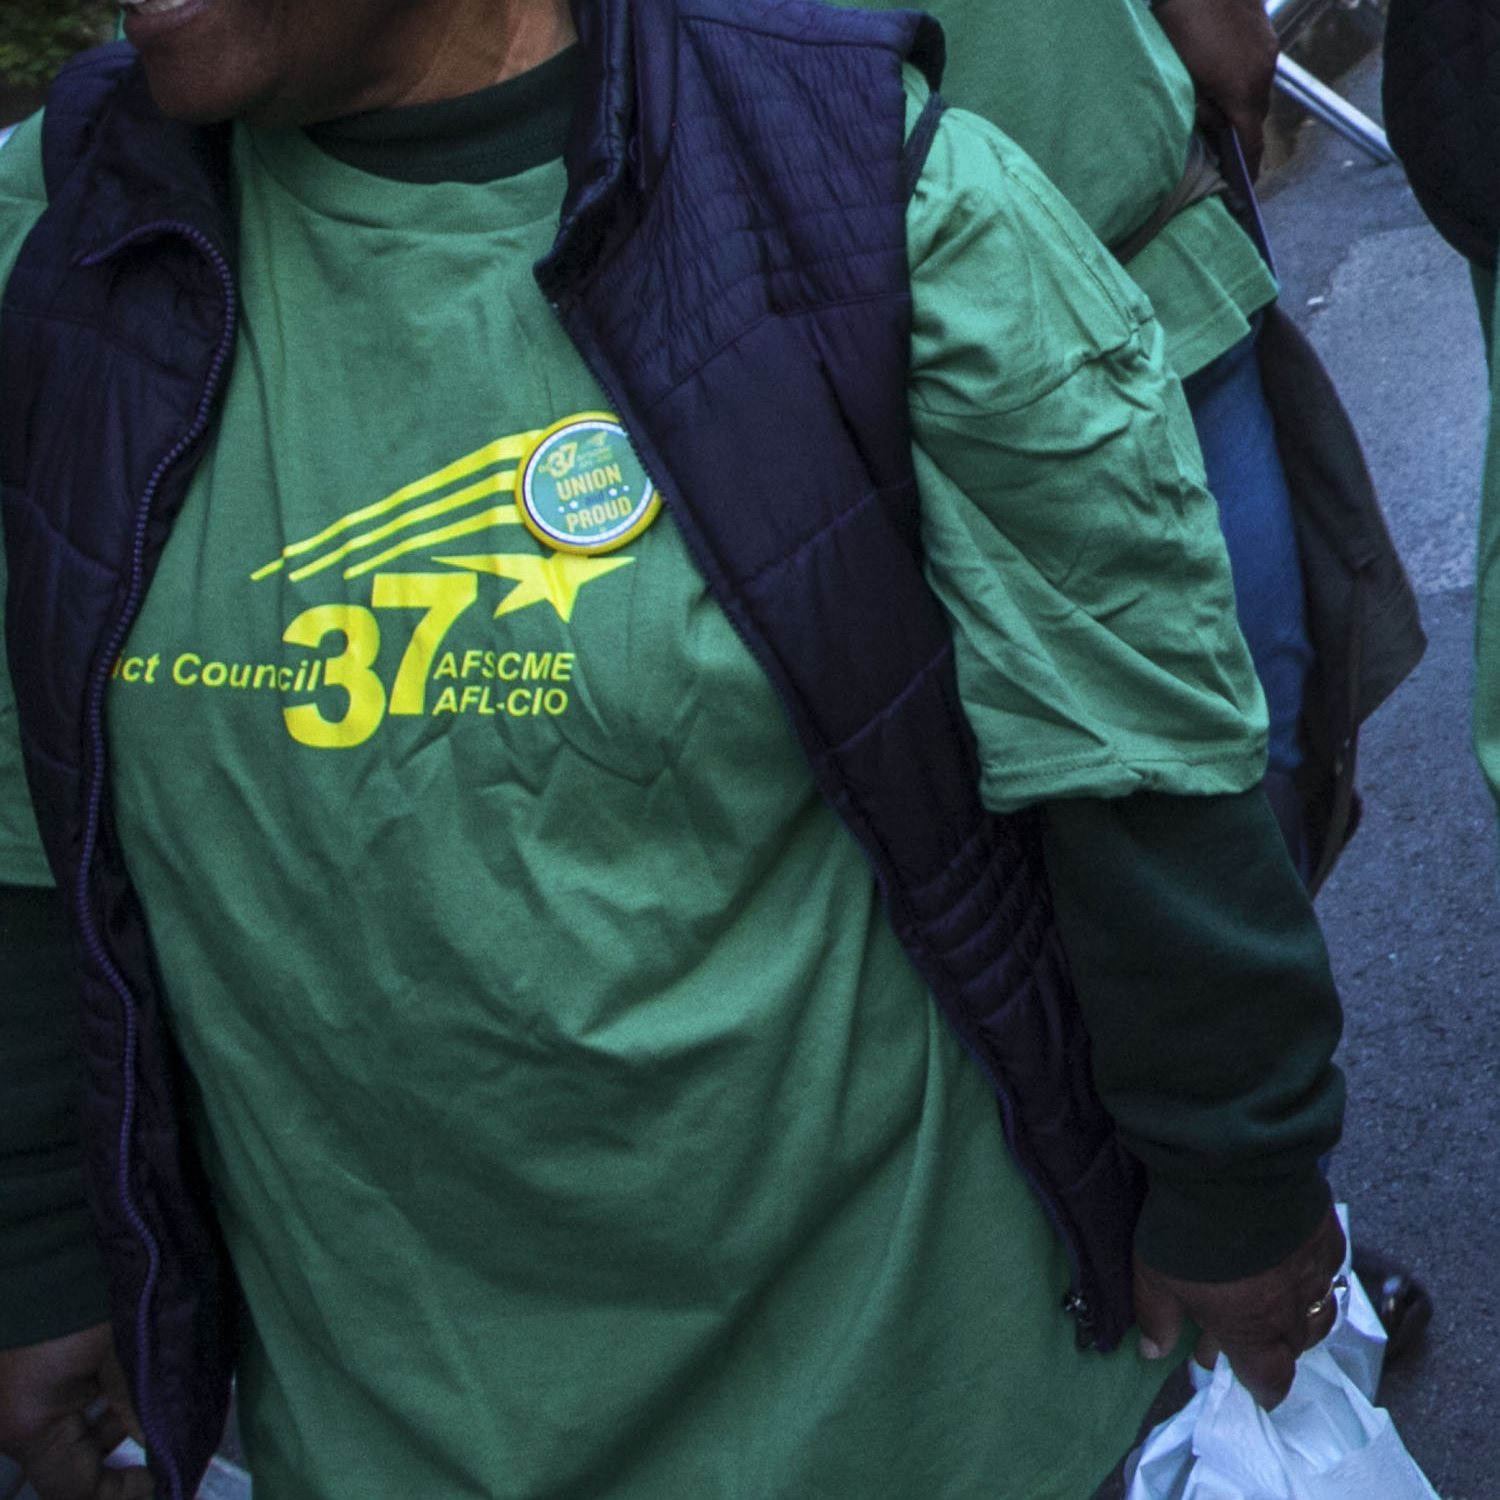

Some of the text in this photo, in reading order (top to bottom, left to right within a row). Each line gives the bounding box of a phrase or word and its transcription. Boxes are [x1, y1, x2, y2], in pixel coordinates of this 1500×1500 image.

[556, 462, 622, 501] UNION
[565, 496, 633, 534] PROUD
[172, 572, 478, 748] Council 37
[434, 650, 575, 683] AFSCME
[432, 686, 569, 716] AFL-CIO
